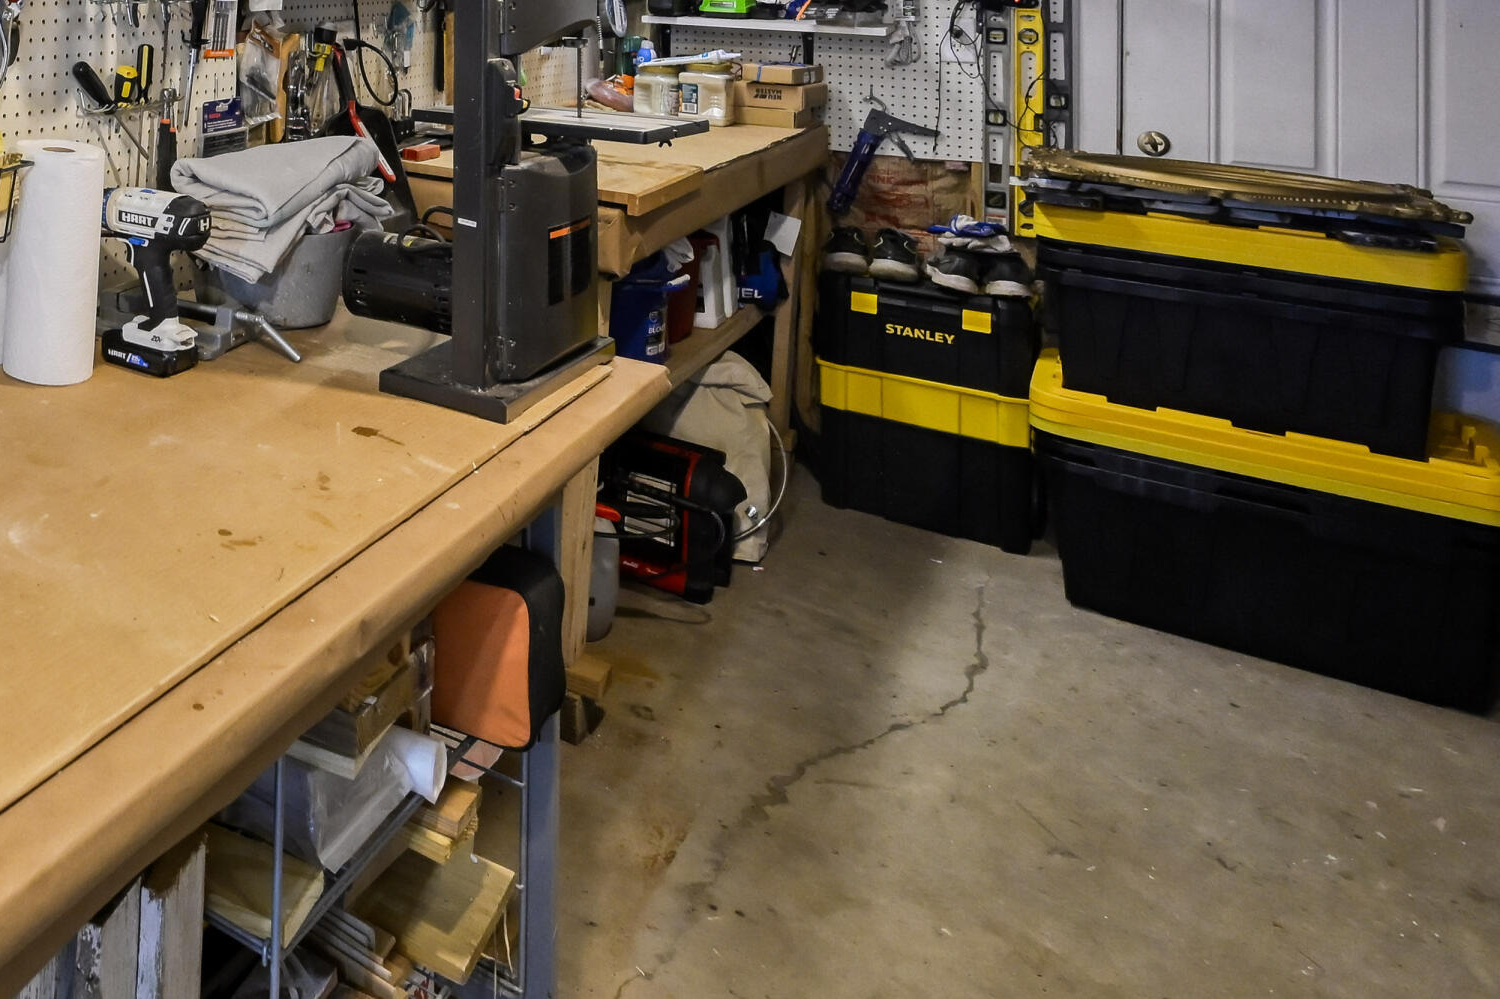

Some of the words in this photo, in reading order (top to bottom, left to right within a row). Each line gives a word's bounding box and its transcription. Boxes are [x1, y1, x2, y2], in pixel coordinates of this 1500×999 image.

[121, 211, 154, 227] HART
[200, 217, 210, 232] H
[884, 323, 956, 345] STANLEY
